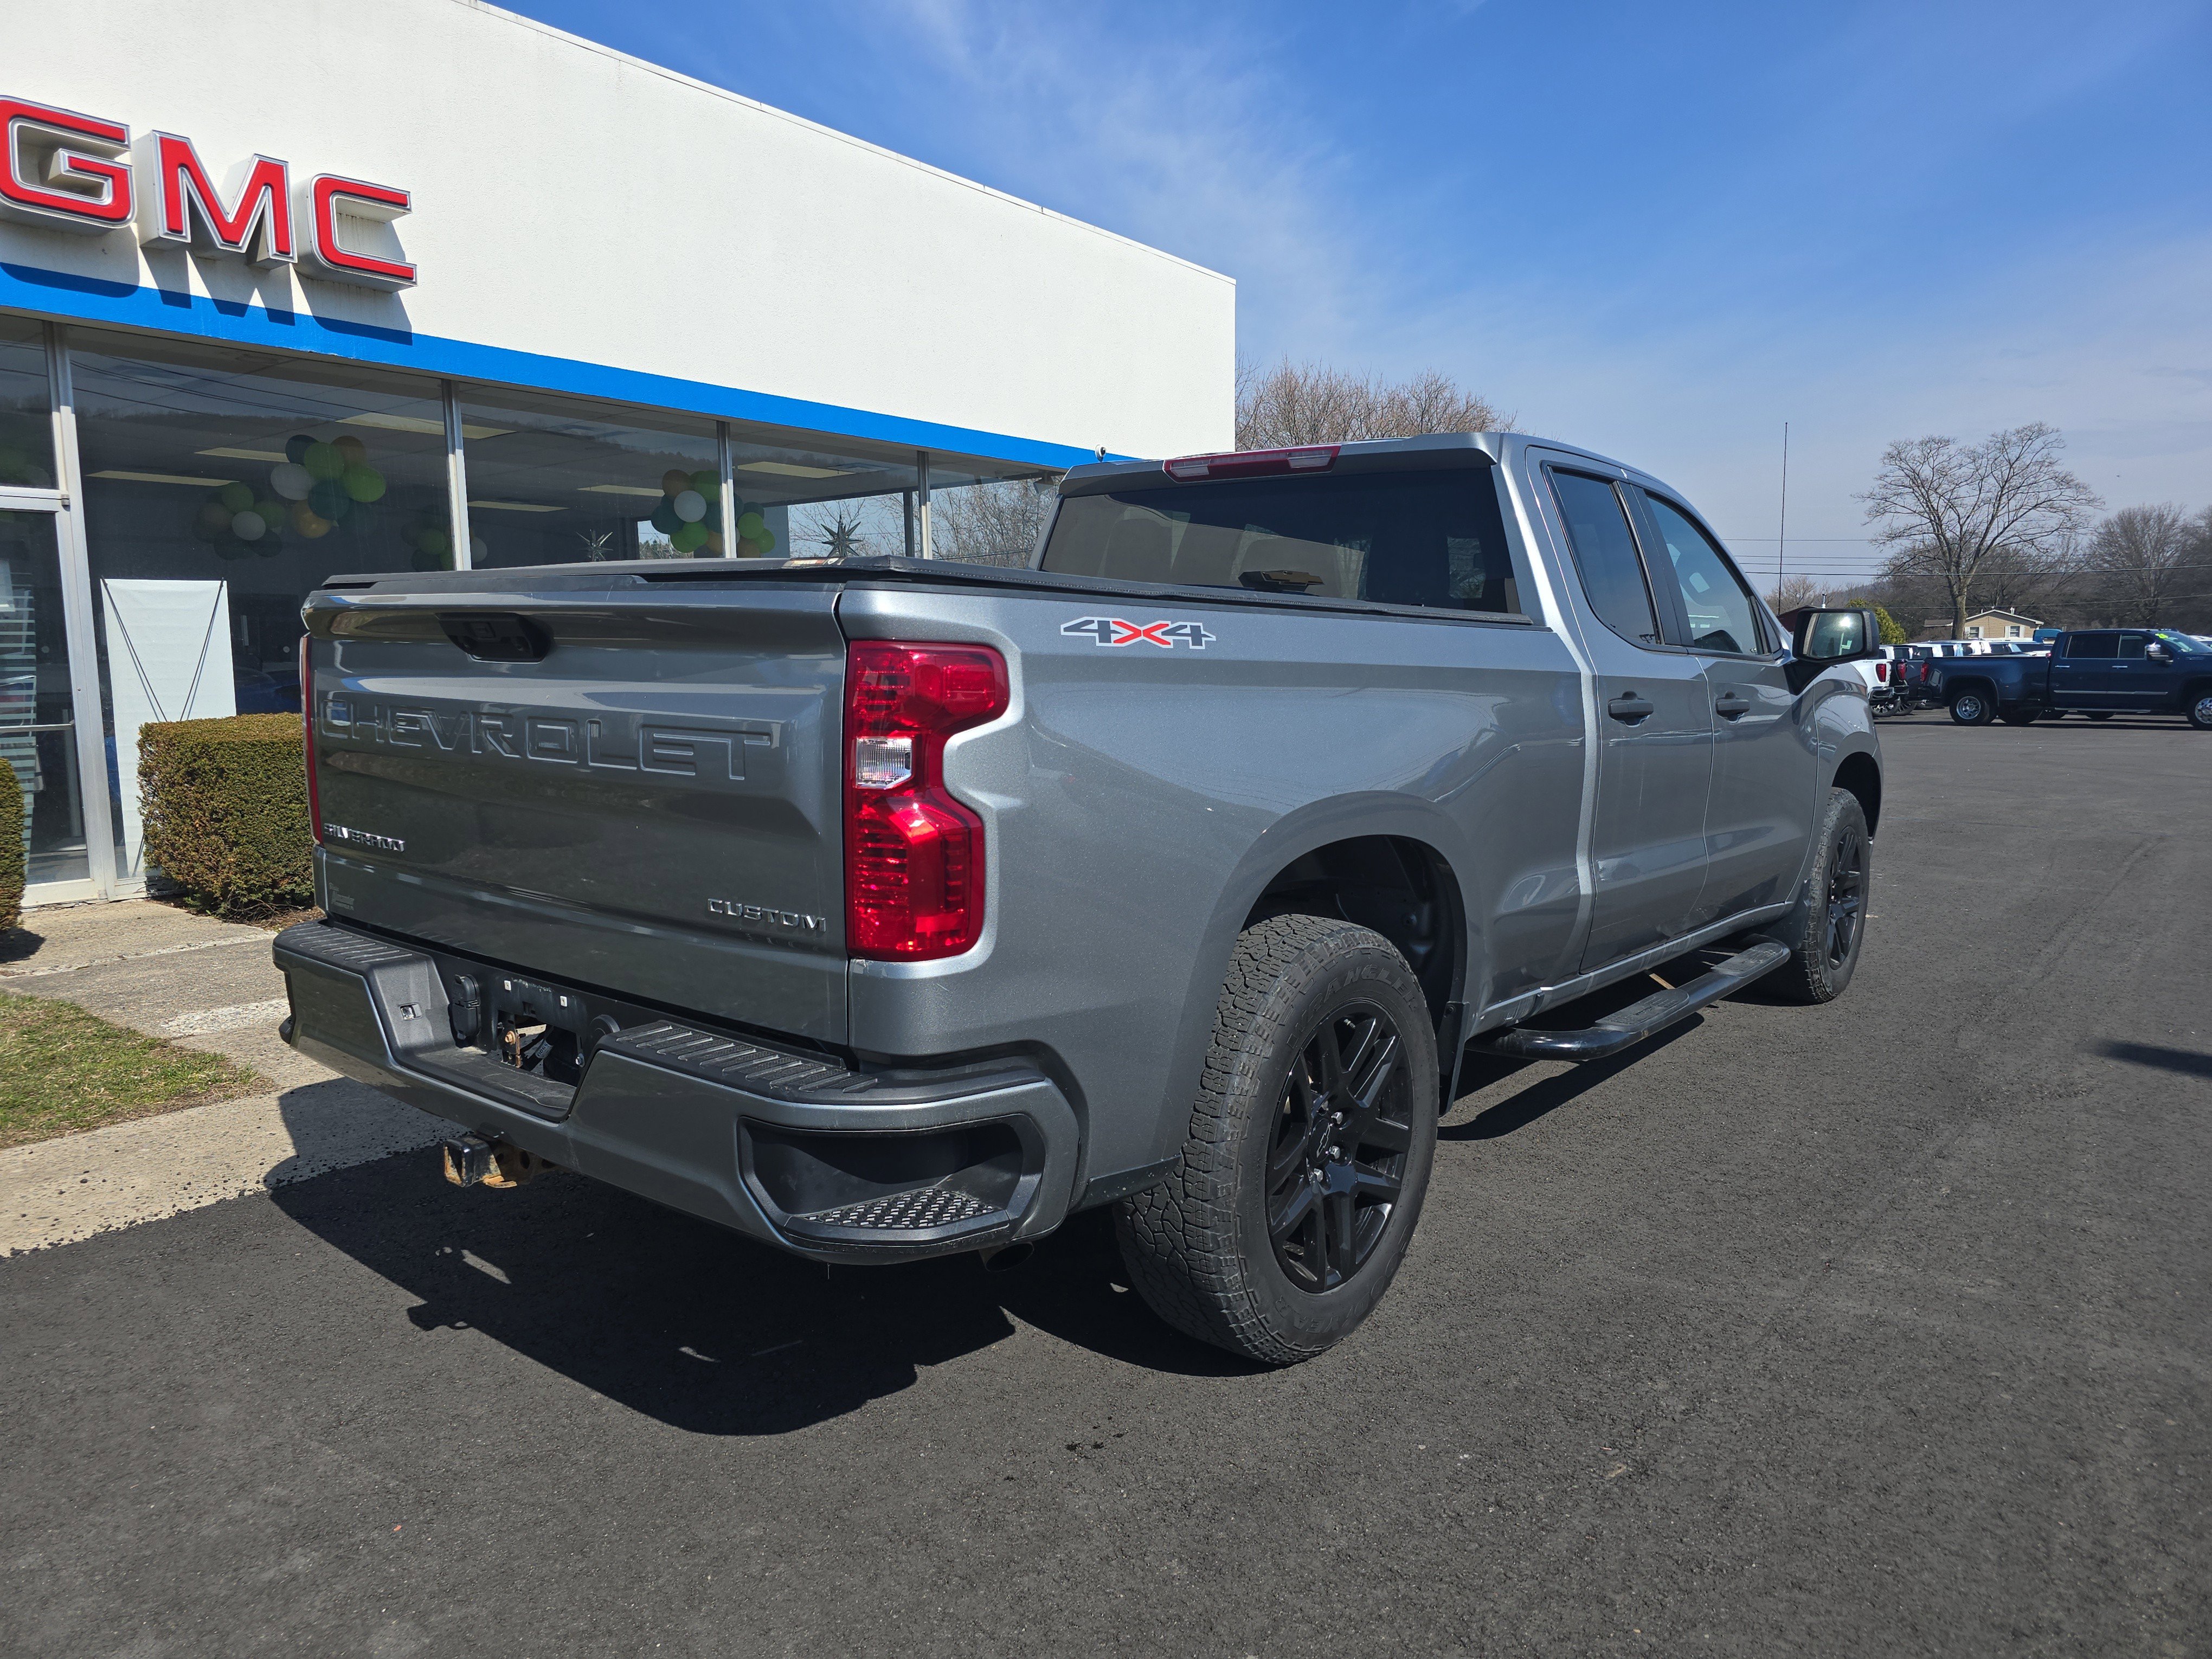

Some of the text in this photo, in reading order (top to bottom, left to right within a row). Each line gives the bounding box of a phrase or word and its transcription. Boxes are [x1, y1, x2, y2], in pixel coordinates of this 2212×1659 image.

[0, 94, 417, 287] GMC
[320, 698, 771, 781] CHEVROLET
[324, 822, 406, 852] SILVERADO
[708, 898, 827, 932] CUSTOM
